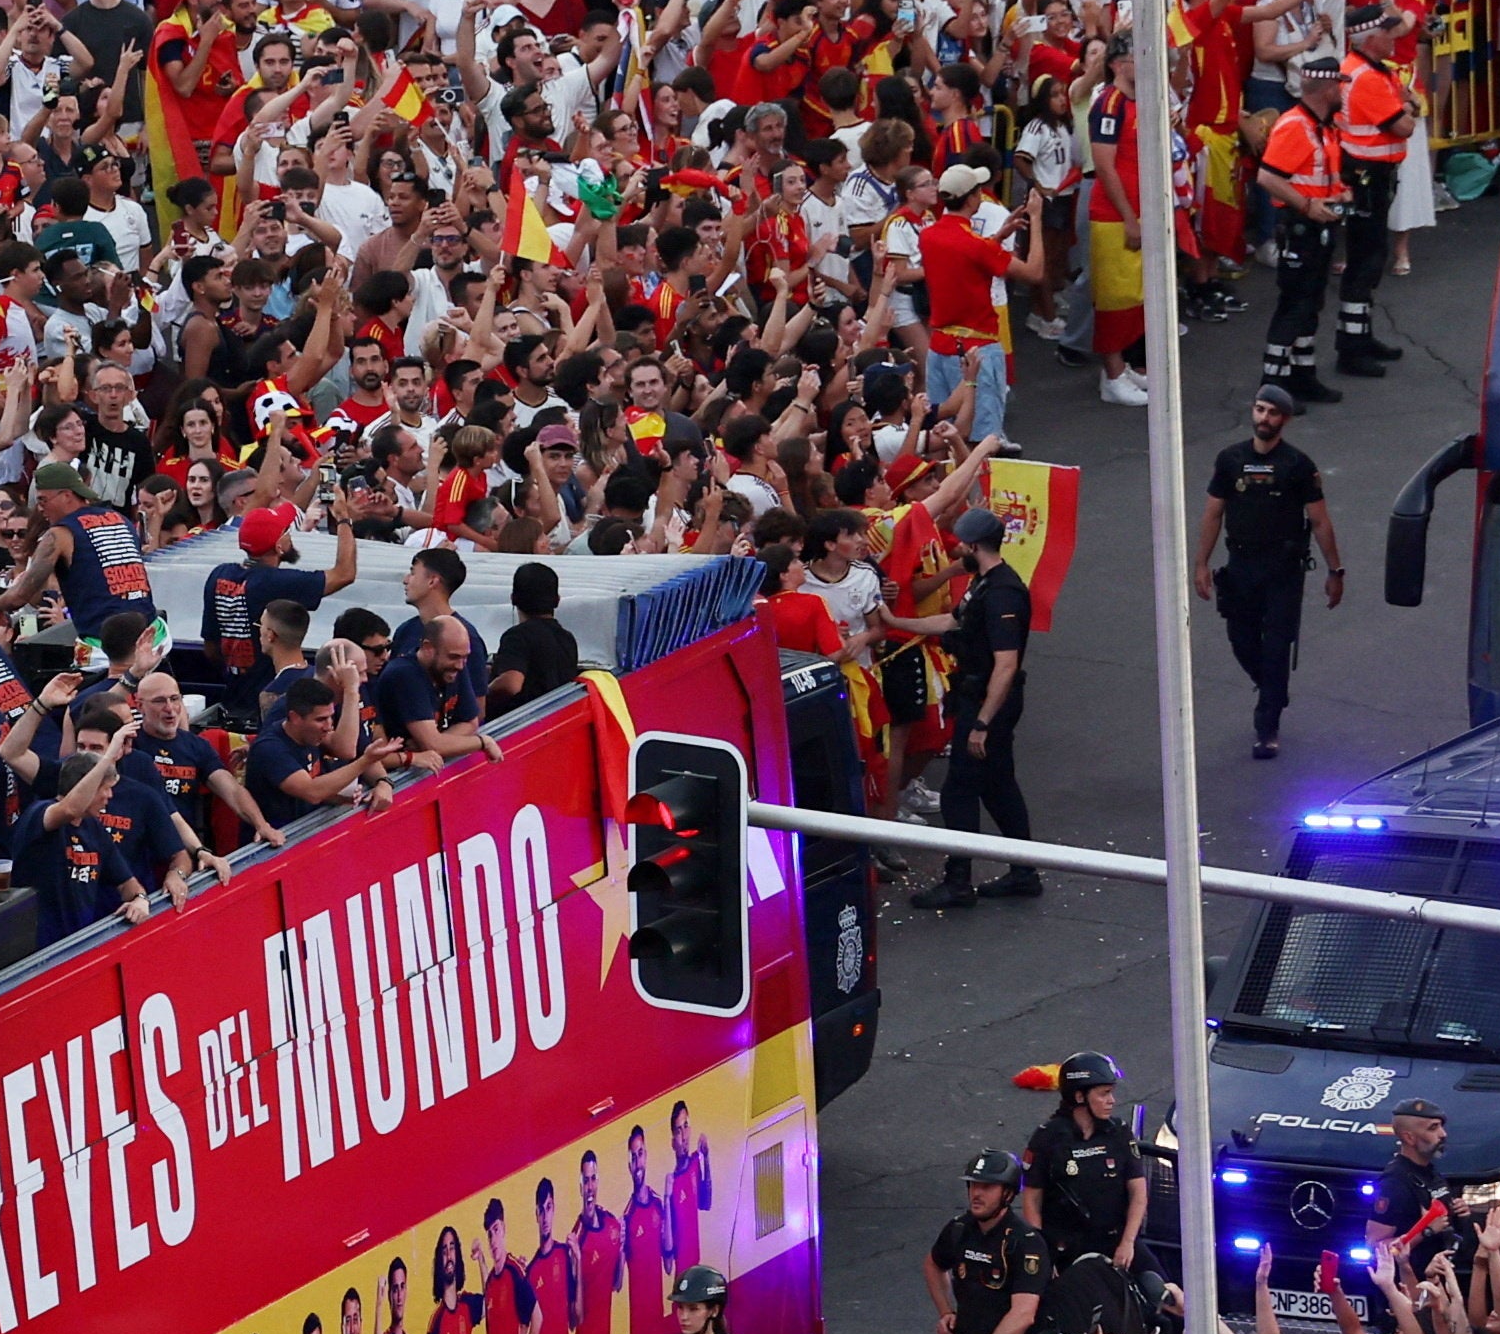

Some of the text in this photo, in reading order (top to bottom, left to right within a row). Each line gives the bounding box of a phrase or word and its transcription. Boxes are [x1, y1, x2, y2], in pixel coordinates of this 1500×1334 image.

[78, 512, 124, 534] ESPAÑA
[199, 1010, 271, 1152] DEL
[264, 803, 567, 1182] MUNDO
[1256, 1112, 1378, 1136] POLICIA
[1268, 1294, 1367, 1323] CNP386D
